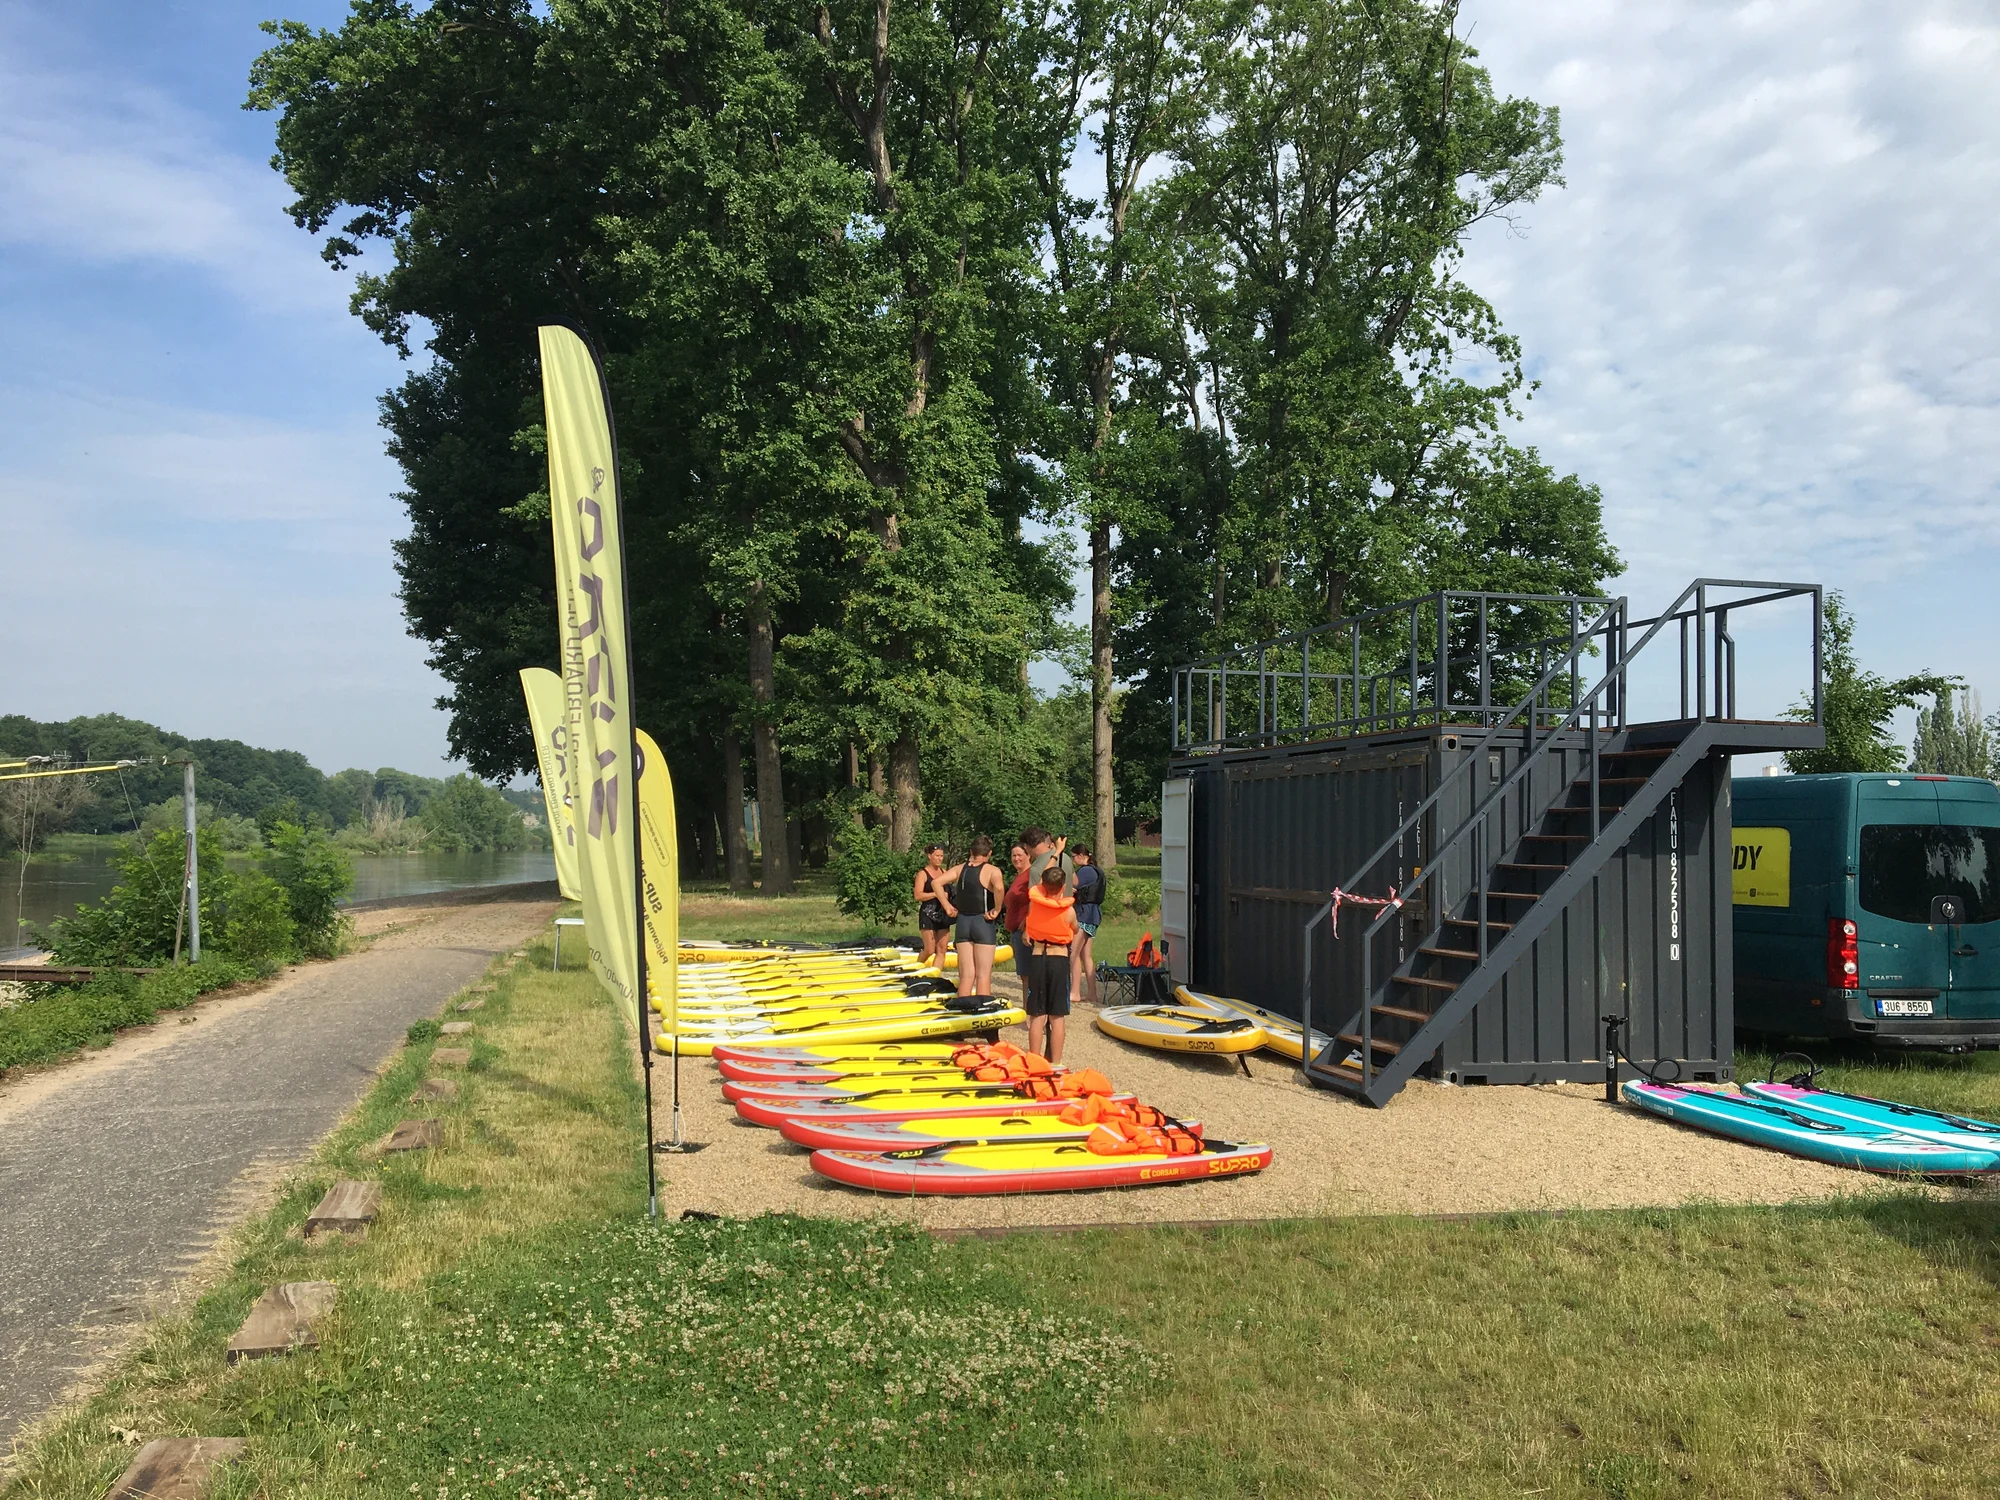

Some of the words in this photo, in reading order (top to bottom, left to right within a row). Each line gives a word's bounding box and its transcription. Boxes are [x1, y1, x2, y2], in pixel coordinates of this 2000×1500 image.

[1670, 791, 1678, 849] FAMU
[1732, 845, 1763, 870] DY
[1670, 852, 1679, 938] 822508
[678, 953, 705, 962] PRO
[1884, 1001, 1901, 1012] 3U6
[1906, 1001, 1929, 1012] 8550
[972, 1017, 1011, 1030] SUPRO
[1188, 1040, 1215, 1051] SUPRO
[1151, 1168, 1179, 1177] CORSAIR
[1209, 1156, 1261, 1174] SUPRO
